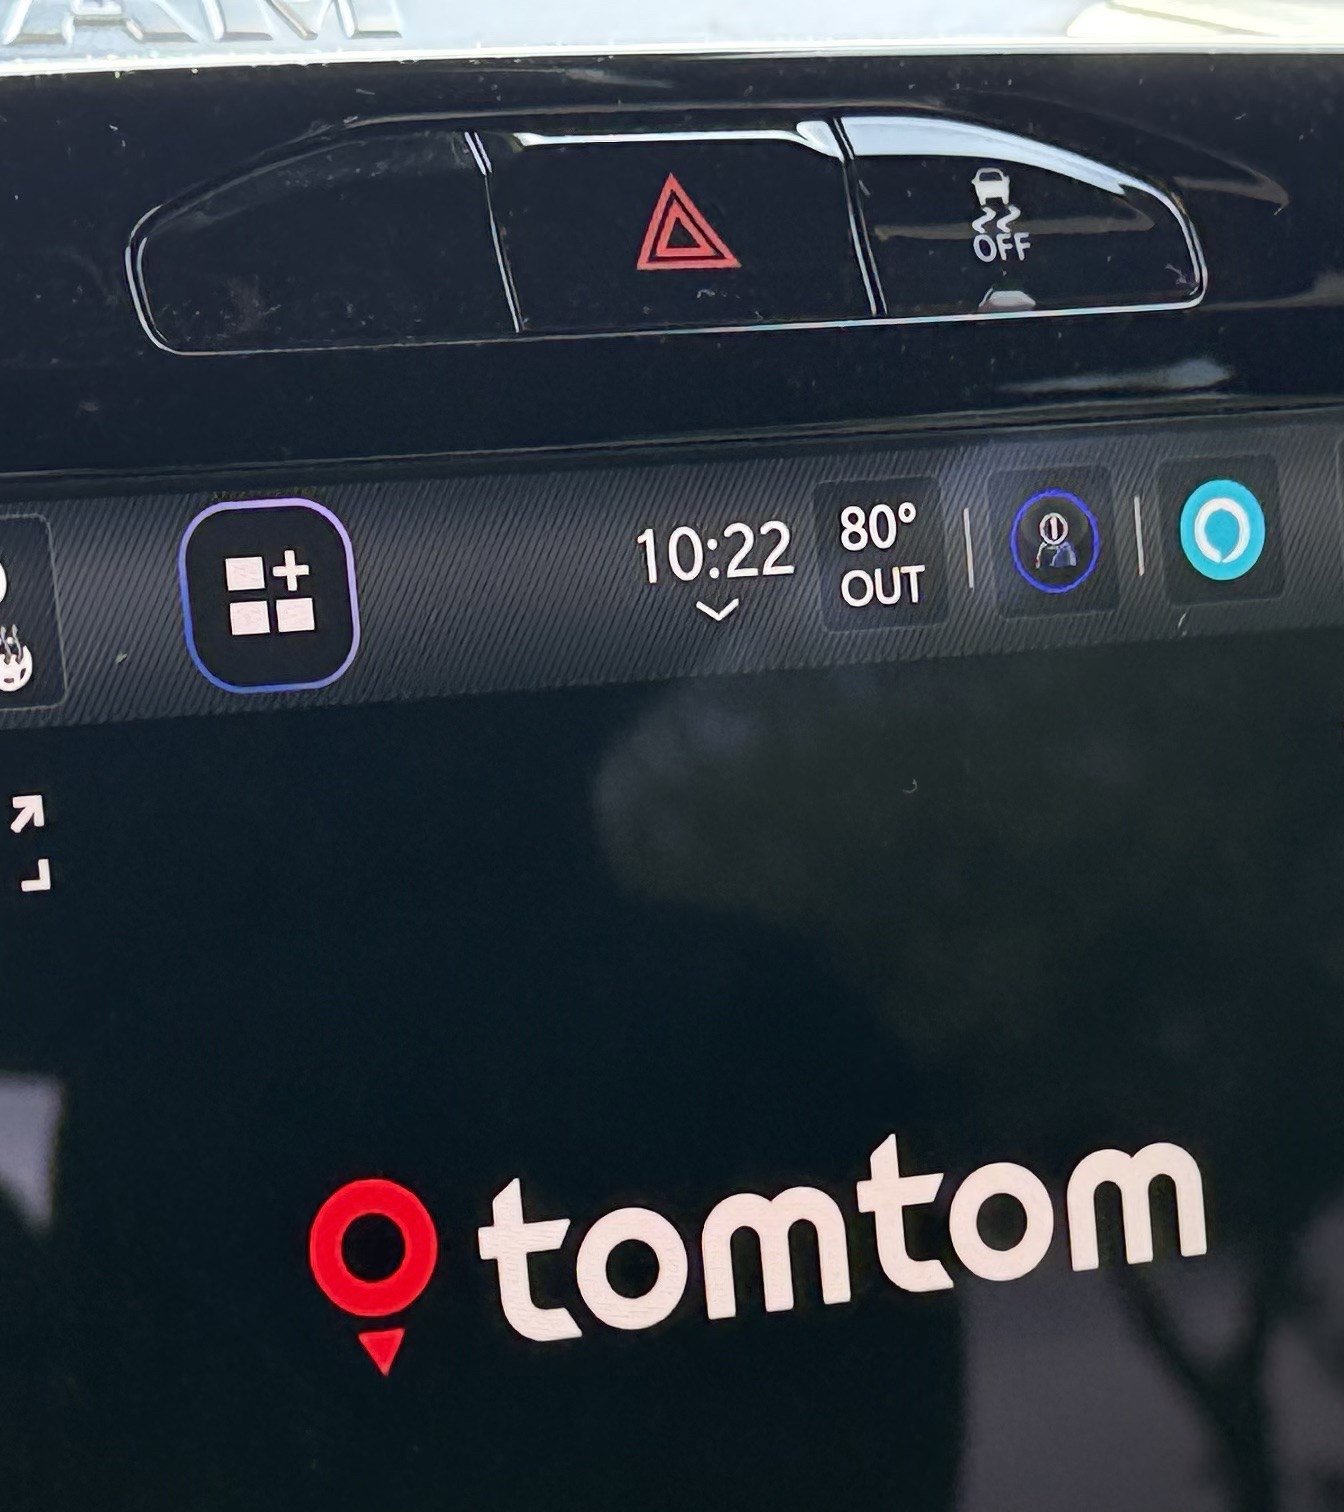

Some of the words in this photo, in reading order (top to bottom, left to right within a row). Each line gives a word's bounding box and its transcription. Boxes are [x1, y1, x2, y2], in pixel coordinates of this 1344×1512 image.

[973, 231, 1031, 263] OFF
[636, 520, 795, 584] 10:22
[840, 564, 926, 608] OUT
[476, 1132, 1209, 1344] tomtom
